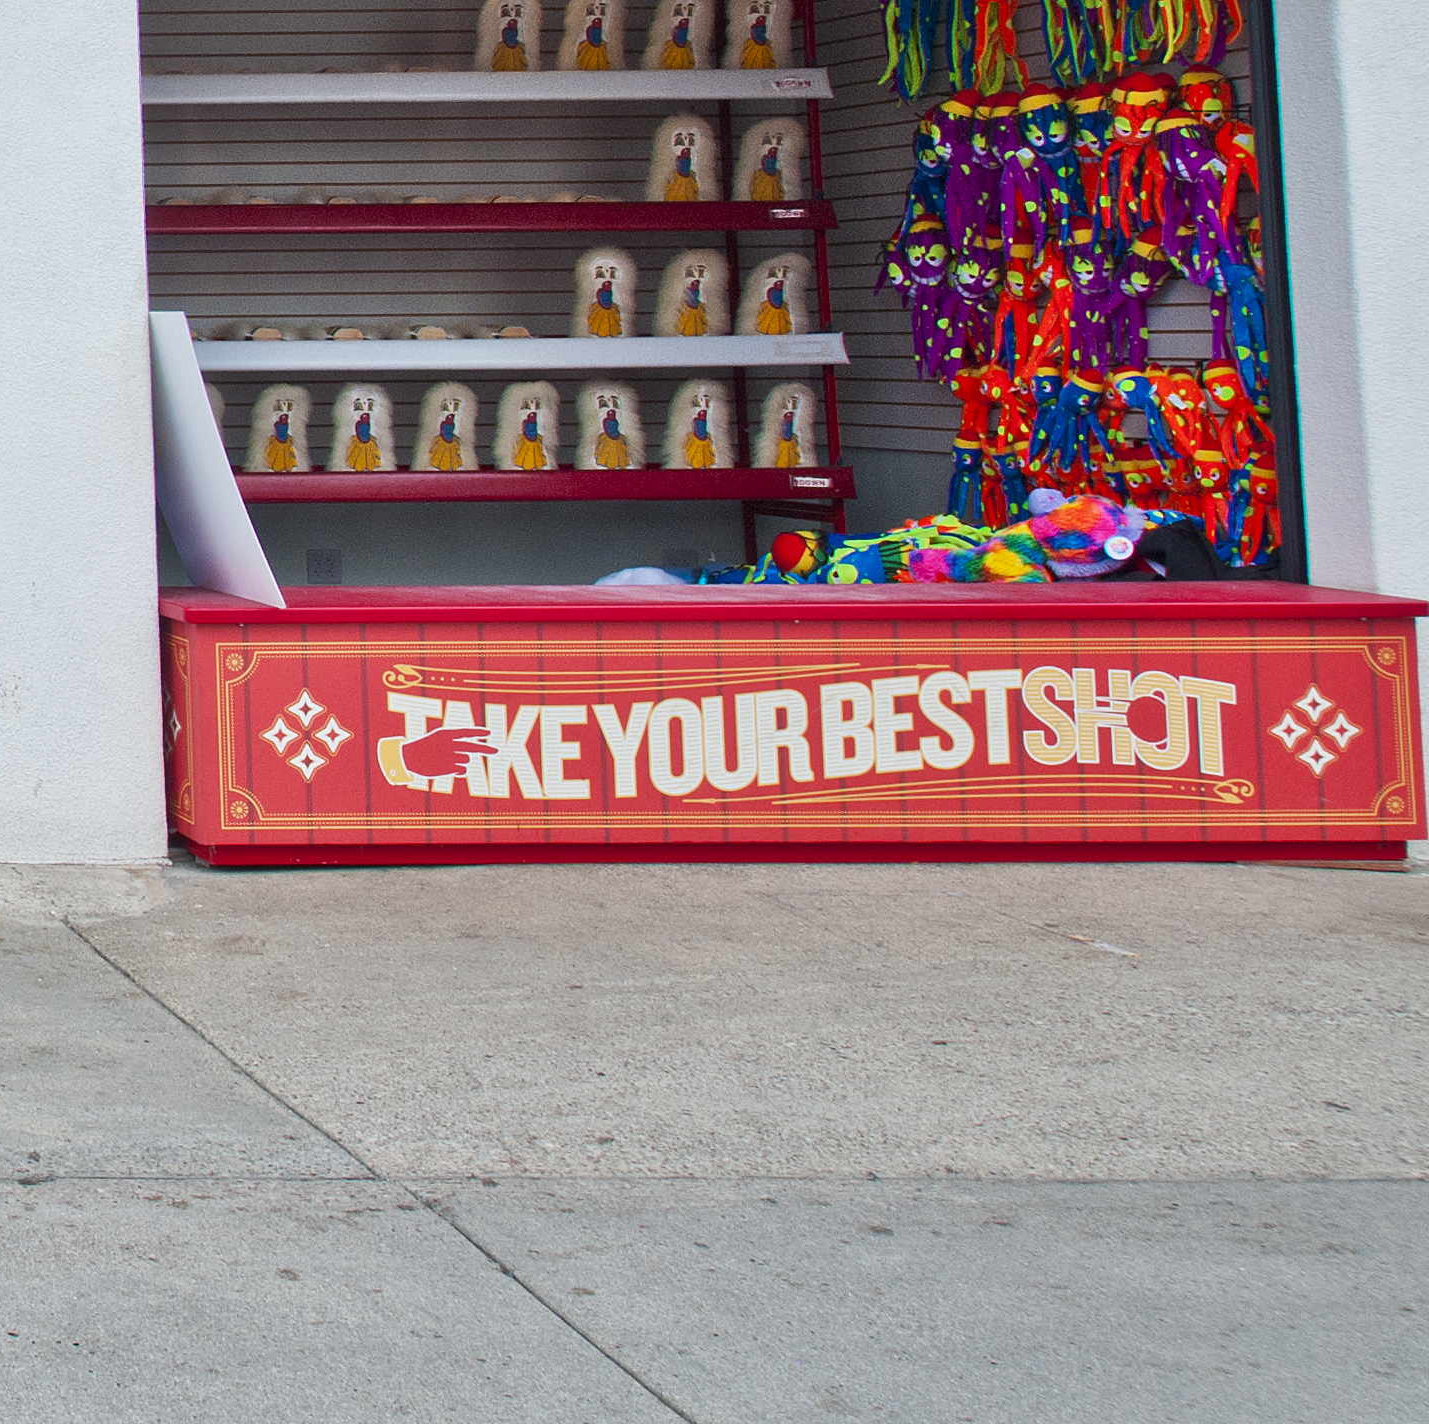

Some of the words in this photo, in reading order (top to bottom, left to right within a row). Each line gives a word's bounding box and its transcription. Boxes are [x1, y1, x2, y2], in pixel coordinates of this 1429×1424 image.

[386, 691, 591, 801] TAKE
[592, 688, 814, 798] YOUR
[820, 669, 1023, 780] BEST
[1021, 664, 1238, 777] SHOT
